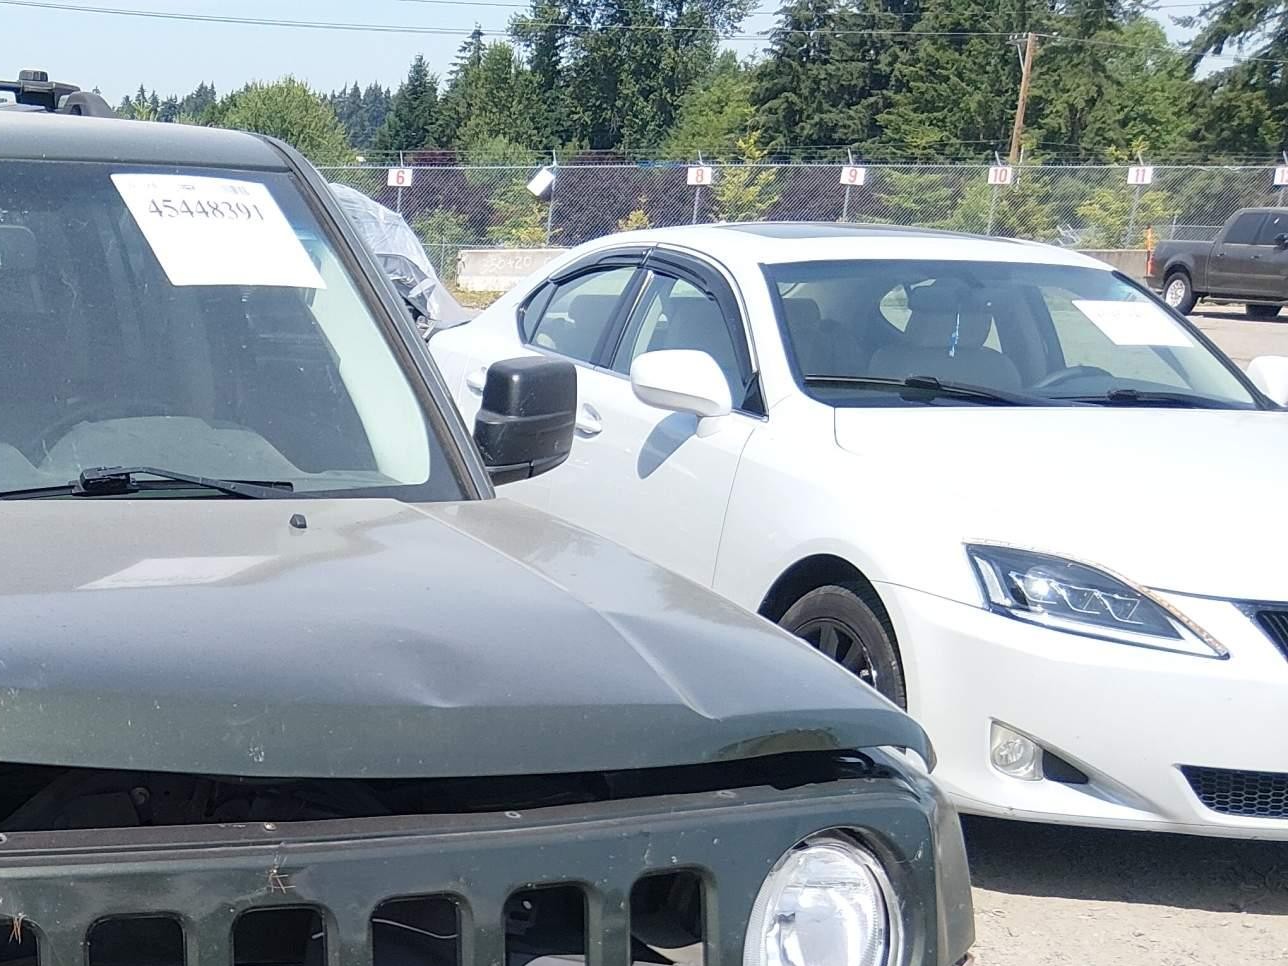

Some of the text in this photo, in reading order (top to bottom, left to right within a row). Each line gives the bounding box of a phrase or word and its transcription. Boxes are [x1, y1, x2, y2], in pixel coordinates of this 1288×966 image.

[396, 169, 405, 185] 6
[696, 168, 704, 184] 8
[848, 168, 858, 184] 9
[993, 168, 1008, 183] 10
[1135, 168, 1146, 183] 11
[148, 199, 265, 221] 45448391
